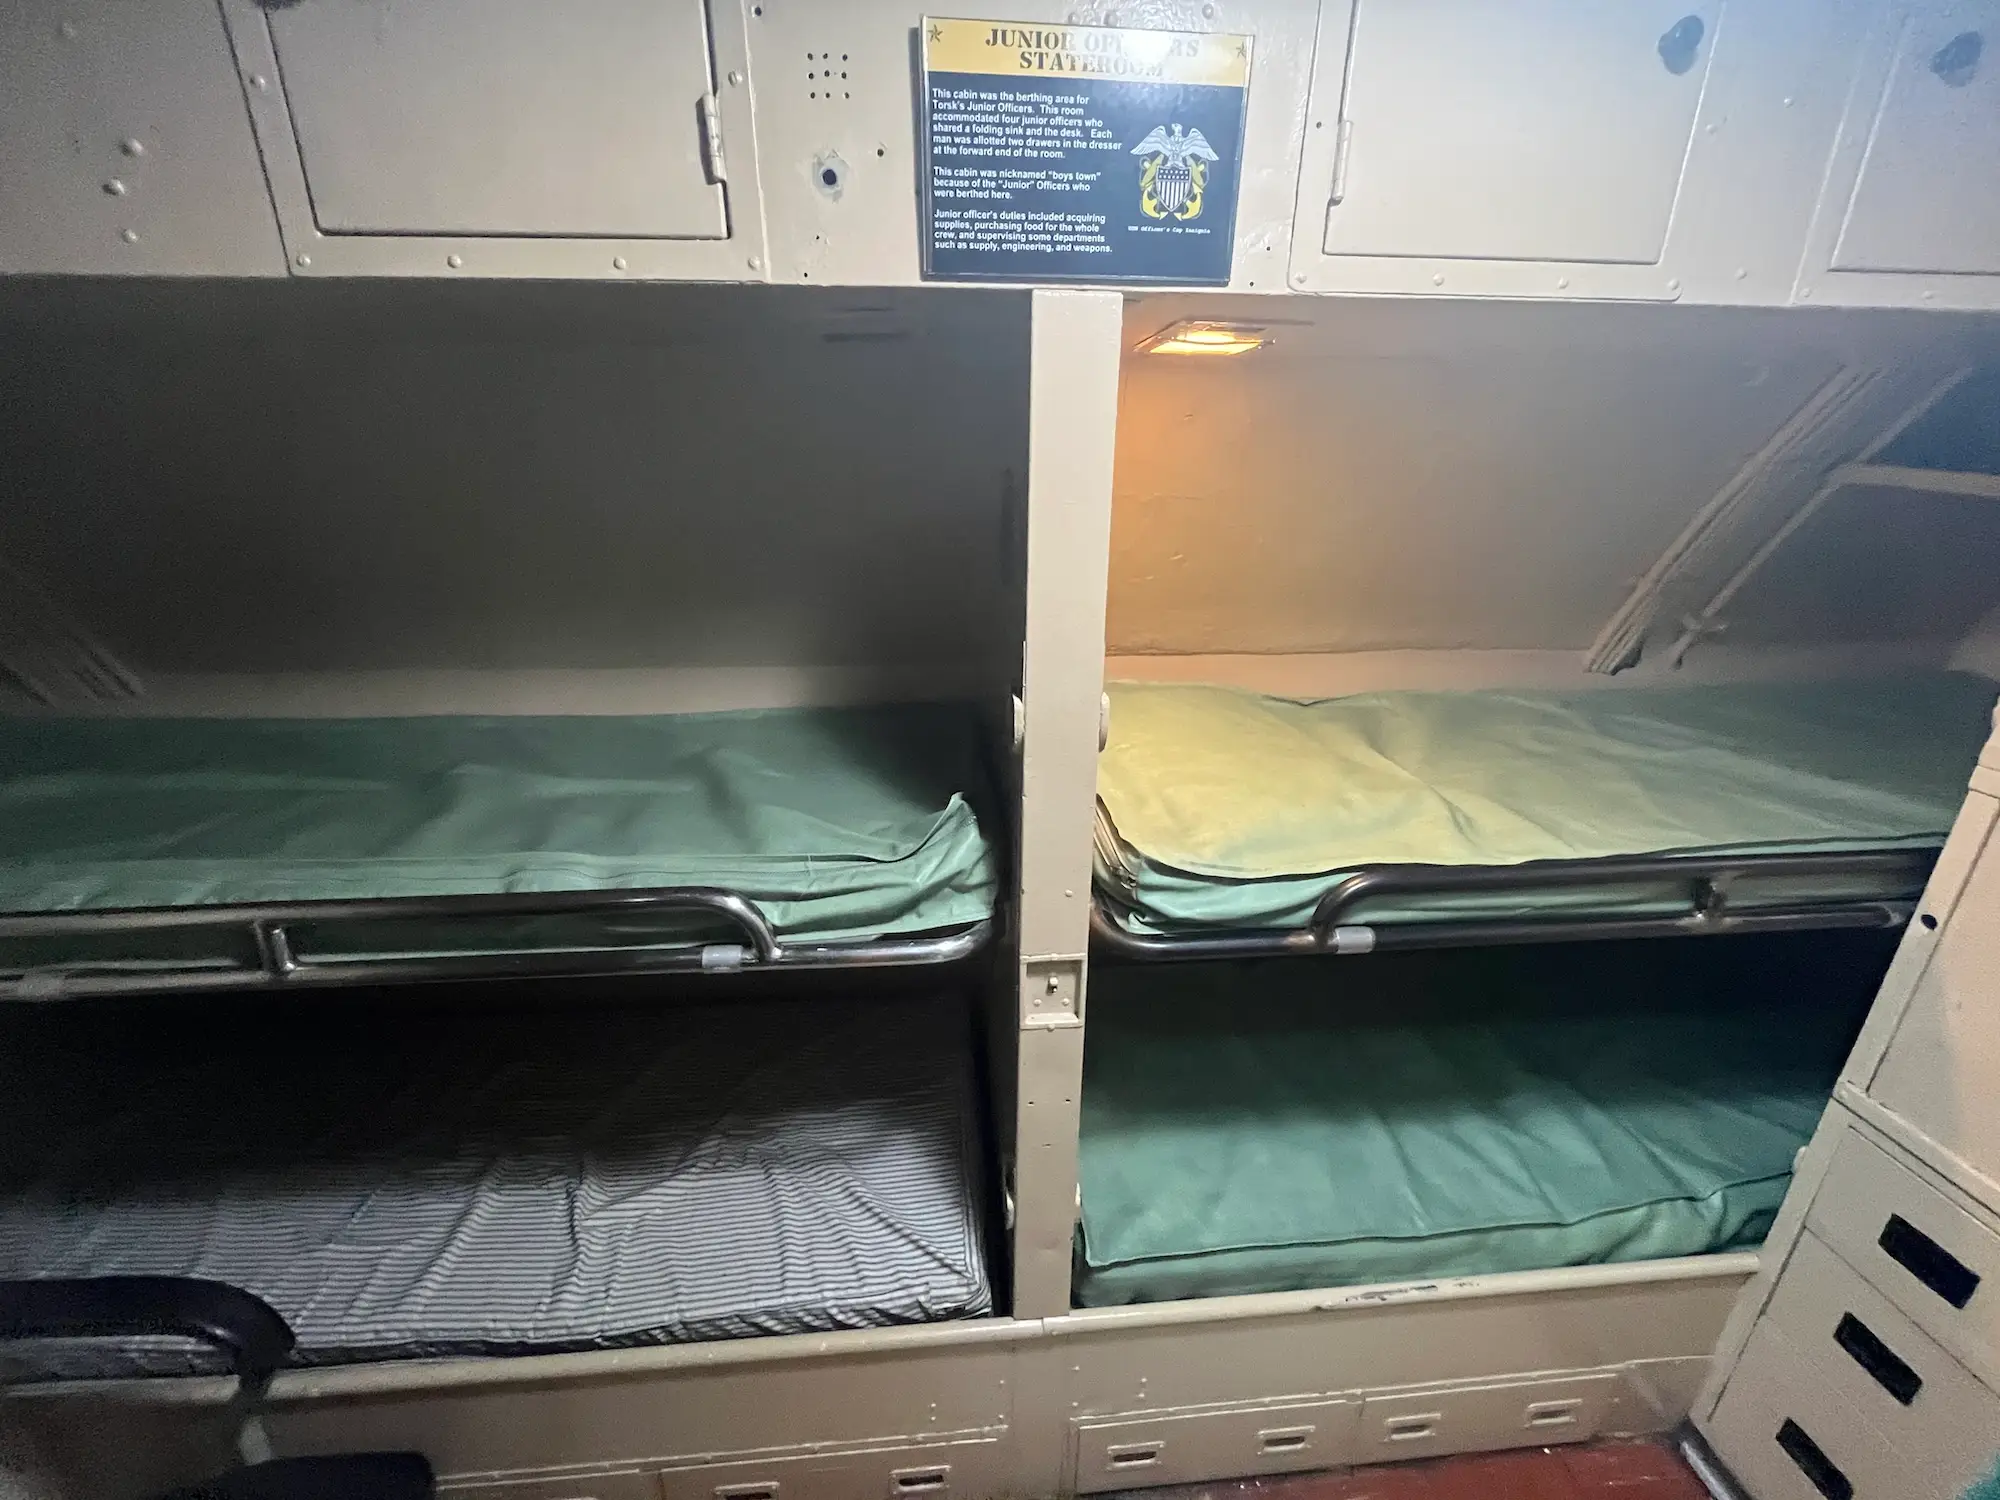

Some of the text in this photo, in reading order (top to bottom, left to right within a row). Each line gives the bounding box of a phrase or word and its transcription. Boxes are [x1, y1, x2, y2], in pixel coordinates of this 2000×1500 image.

[985, 28, 1076, 51] JUNIOR
[933, 88, 952, 98] This
[953, 89, 978, 99] cabin
[980, 92, 997, 100] was
[1000, 91, 1014, 100] the
[1016, 92, 1053, 103] berthing
[1077, 95, 1089, 103] for
[967, 101, 996, 111] Junior
[1040, 103, 1058, 114] This
[933, 113, 1103, 126] accommodated four junior officers who
[933, 122, 962, 132] shared
[964, 125, 970, 133] a
[972, 124, 1003, 136] folding
[1005, 124, 1023, 135] sink
[1026, 127, 1042, 135] and
[1044, 127, 1058, 136] the
[1091, 129, 1112, 138] Each
[954, 136, 971, 144] was
[973, 135, 1006, 145] allotted
[1008, 137, 1024, 146] two
[1026, 137, 1060, 147] drawers
[1063, 139, 1071, 148] in
[1074, 139, 1087, 148] the
[1089, 140, 1122, 150] dresser
[933, 144, 942, 154] at
[944, 145, 957, 154] the
[959, 145, 993, 156] forward
[995, 147, 1011, 156] end
[1013, 147, 1023, 156] of
[1024, 146, 1038, 157] the
[934, 166, 952, 176] This
[954, 168, 978, 176] cabin
[999, 168, 1046, 179] nicknamed
[934, 176, 968, 187] because
[971, 178, 980, 187] of
[982, 179, 996, 188] the
[1036, 180, 1070, 190] Officers
[1072, 182, 1090, 191] who
[934, 188, 954, 197] were
[956, 187, 989, 198] berthed
[934, 209, 962, 218] Junior
[1000, 210, 1026, 220] duties
[1028, 212, 1064, 222] included
[1066, 213, 1105, 224] acquiring
[974, 218, 1022, 232] purchasing
[1024, 220, 1043, 231] food
[1045, 221, 1056, 231] for
[1059, 221, 1074, 232] the
[1075, 222, 1099, 232] whole
[959, 228, 974, 238] and
[976, 228, 1026, 242] supervising
[1028, 232, 1051, 241] some
[1052, 231, 1105, 244] departments
[935, 237, 955, 248] such
[957, 240, 968, 248] as
[1056, 241, 1072, 251] and
